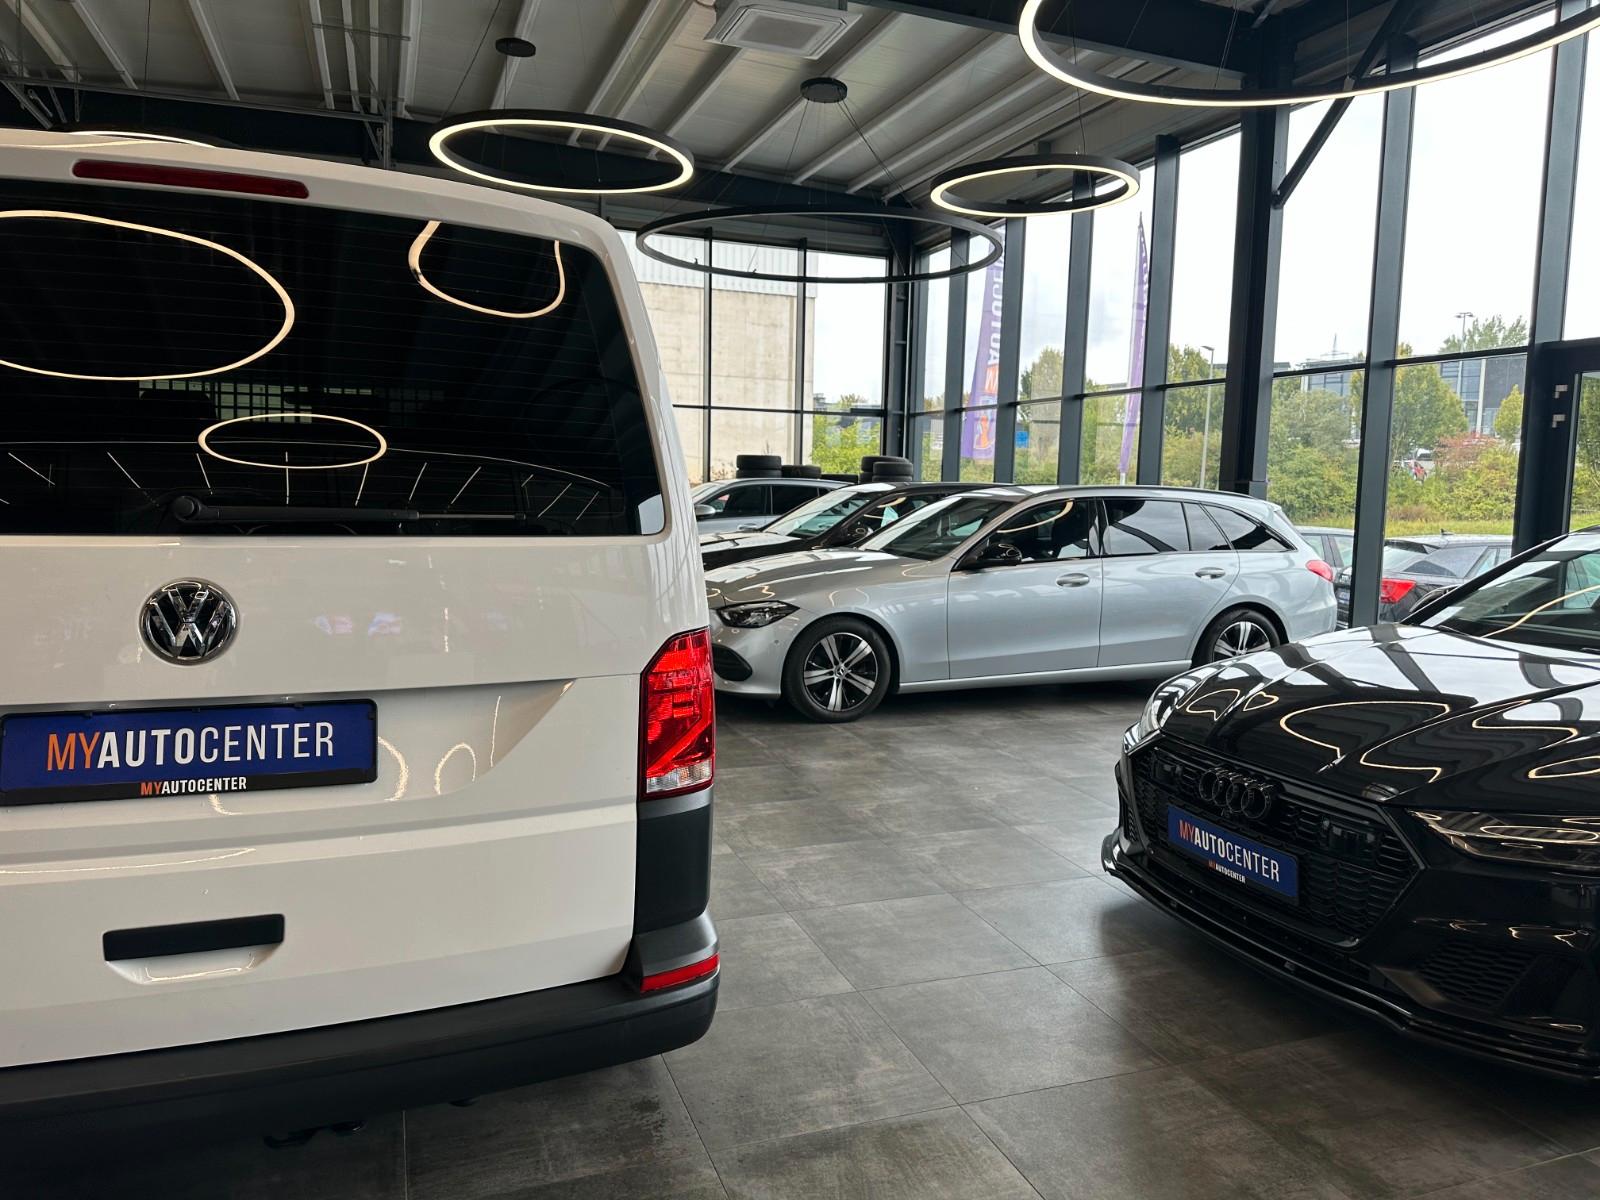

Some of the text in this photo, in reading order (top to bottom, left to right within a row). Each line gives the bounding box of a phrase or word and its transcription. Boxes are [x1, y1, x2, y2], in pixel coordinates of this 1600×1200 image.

[47, 721, 334, 771] MYAUTOCENTER
[140, 776, 247, 796] MYAUTOCENTER
[1179, 819, 1280, 882] MYAUTOCENTER
[1208, 859, 1246, 884] MYAUTOCENTER
